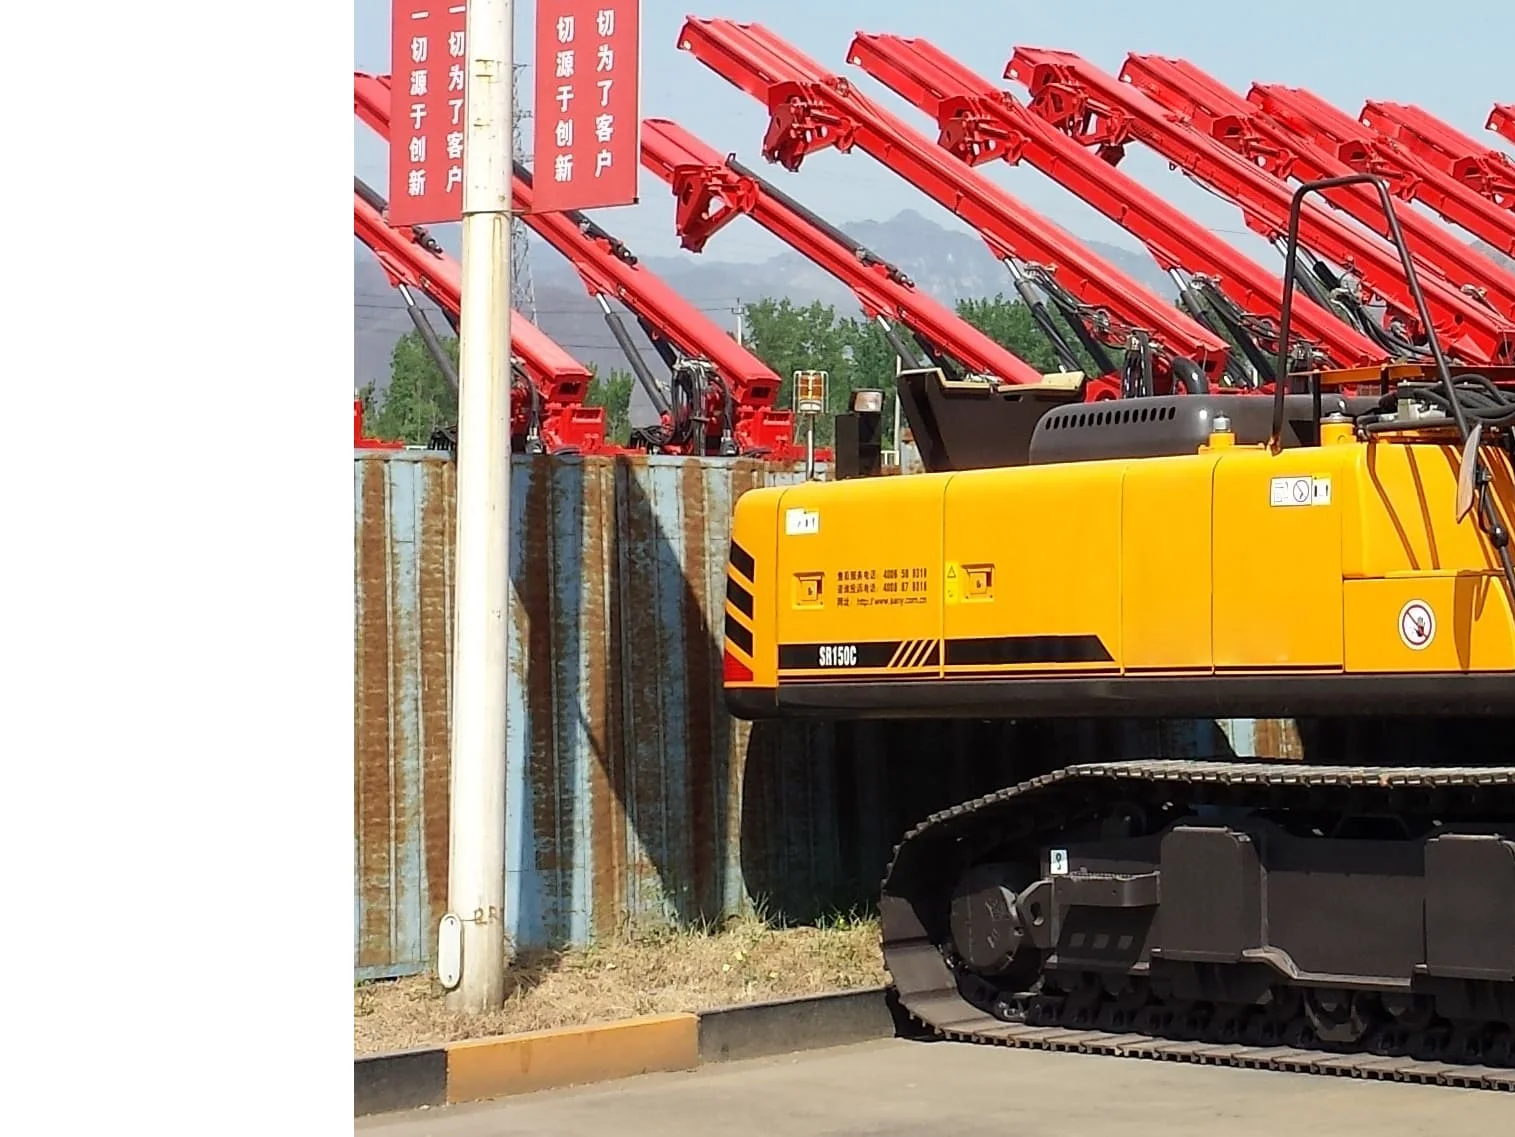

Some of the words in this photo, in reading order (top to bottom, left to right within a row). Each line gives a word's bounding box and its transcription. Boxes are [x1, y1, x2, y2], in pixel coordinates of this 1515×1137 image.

[408, 11, 429, 197] 一切源于创新
[446, 5, 466, 193] 一切为了客户
[819, 645, 857, 666] SR150C
